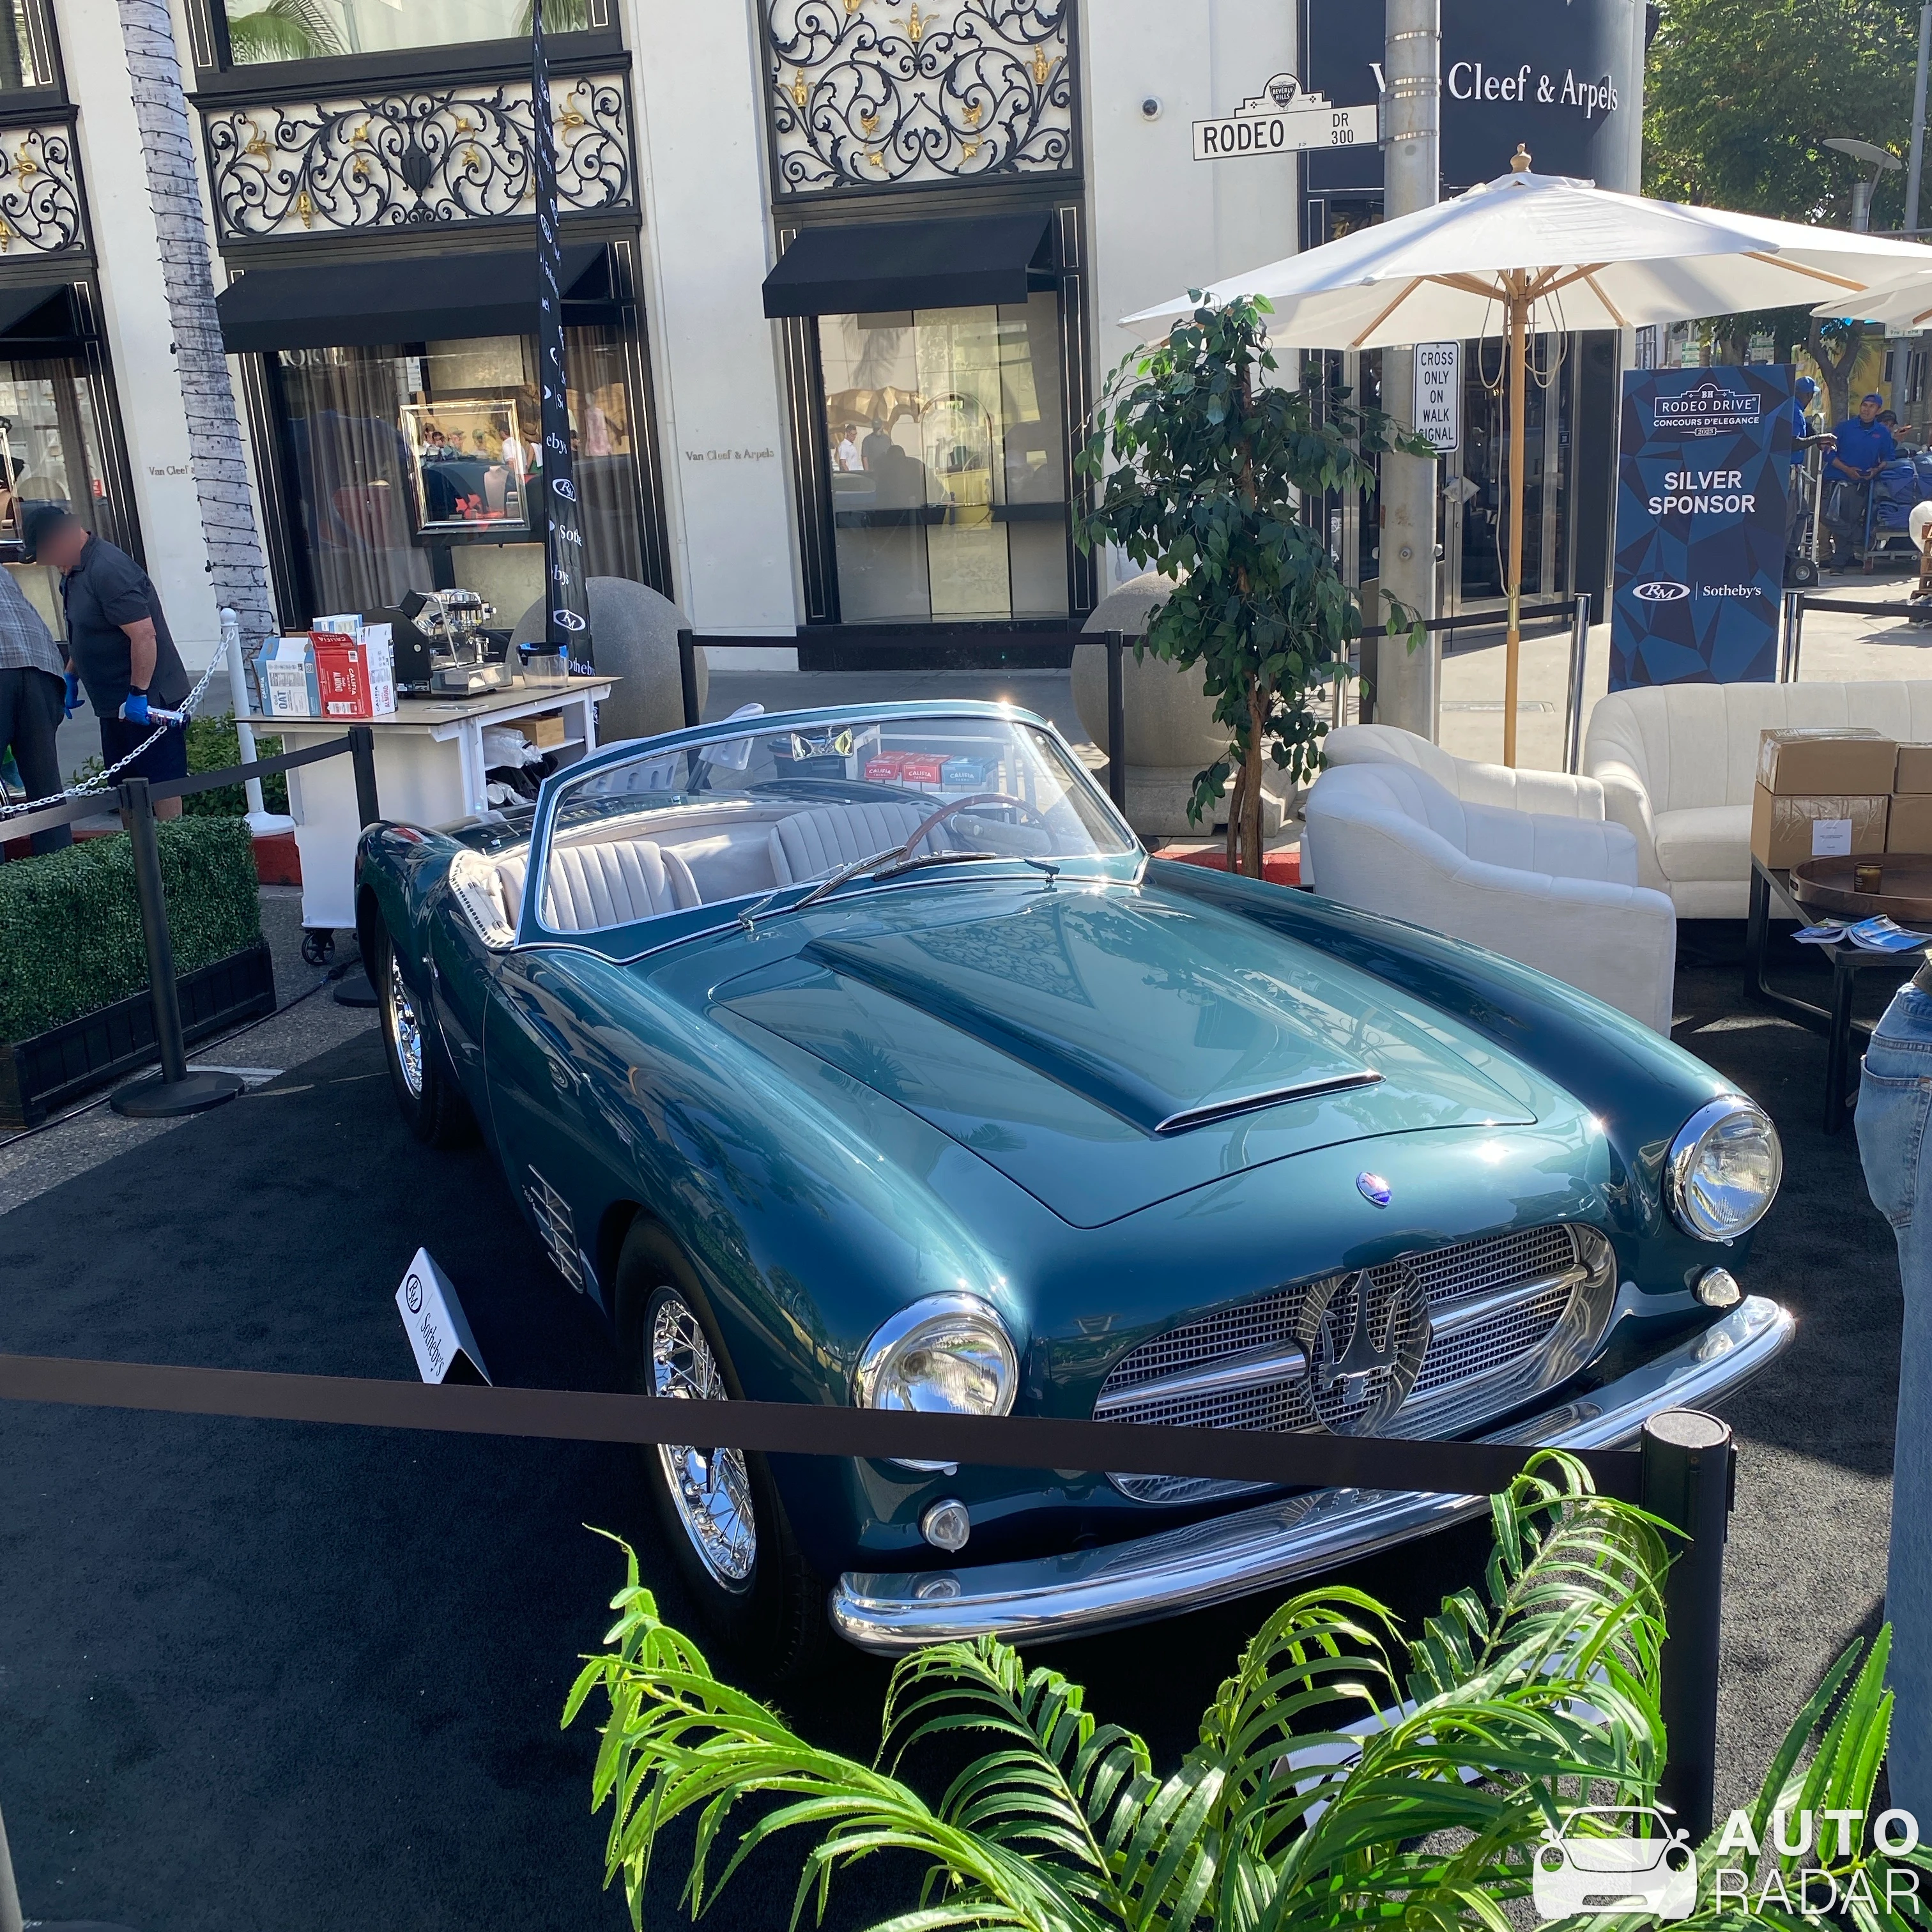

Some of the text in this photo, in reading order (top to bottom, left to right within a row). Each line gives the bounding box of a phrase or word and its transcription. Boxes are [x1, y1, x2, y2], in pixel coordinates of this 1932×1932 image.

[1448, 61, 1618, 119] Cleef & Arpels
[1332, 112, 1349, 127] DR
[1204, 119, 1284, 154] RODEO
[1331, 129, 1354, 145] 300
[1421, 351, 1453, 366] CROSS
[1424, 370, 1450, 385] ONLY
[1430, 389, 1443, 403] ON
[1701, 390, 1714, 399] BH
[1662, 399, 1752, 413] RODEO DRIVE
[1423, 408, 1450, 422] WALK
[1653, 417, 1759, 427] CONCOURS D'ELEGANCE
[685, 447, 774, 461] Van Cleef & Arpels
[148, 466, 165, 476] Van
[166, 464, 189, 475] Cleef
[1664, 470, 1742, 490] SILVER
[1648, 494, 1756, 515] SPONSOR
[1645, 583, 1761, 599] RM Sotheby's
[332, 671, 343, 692] ALMOND
[348, 668, 356, 696] CALIFIA
[277, 690, 288, 709] OAT
[420, 1312, 445, 1377] Sotheby's
